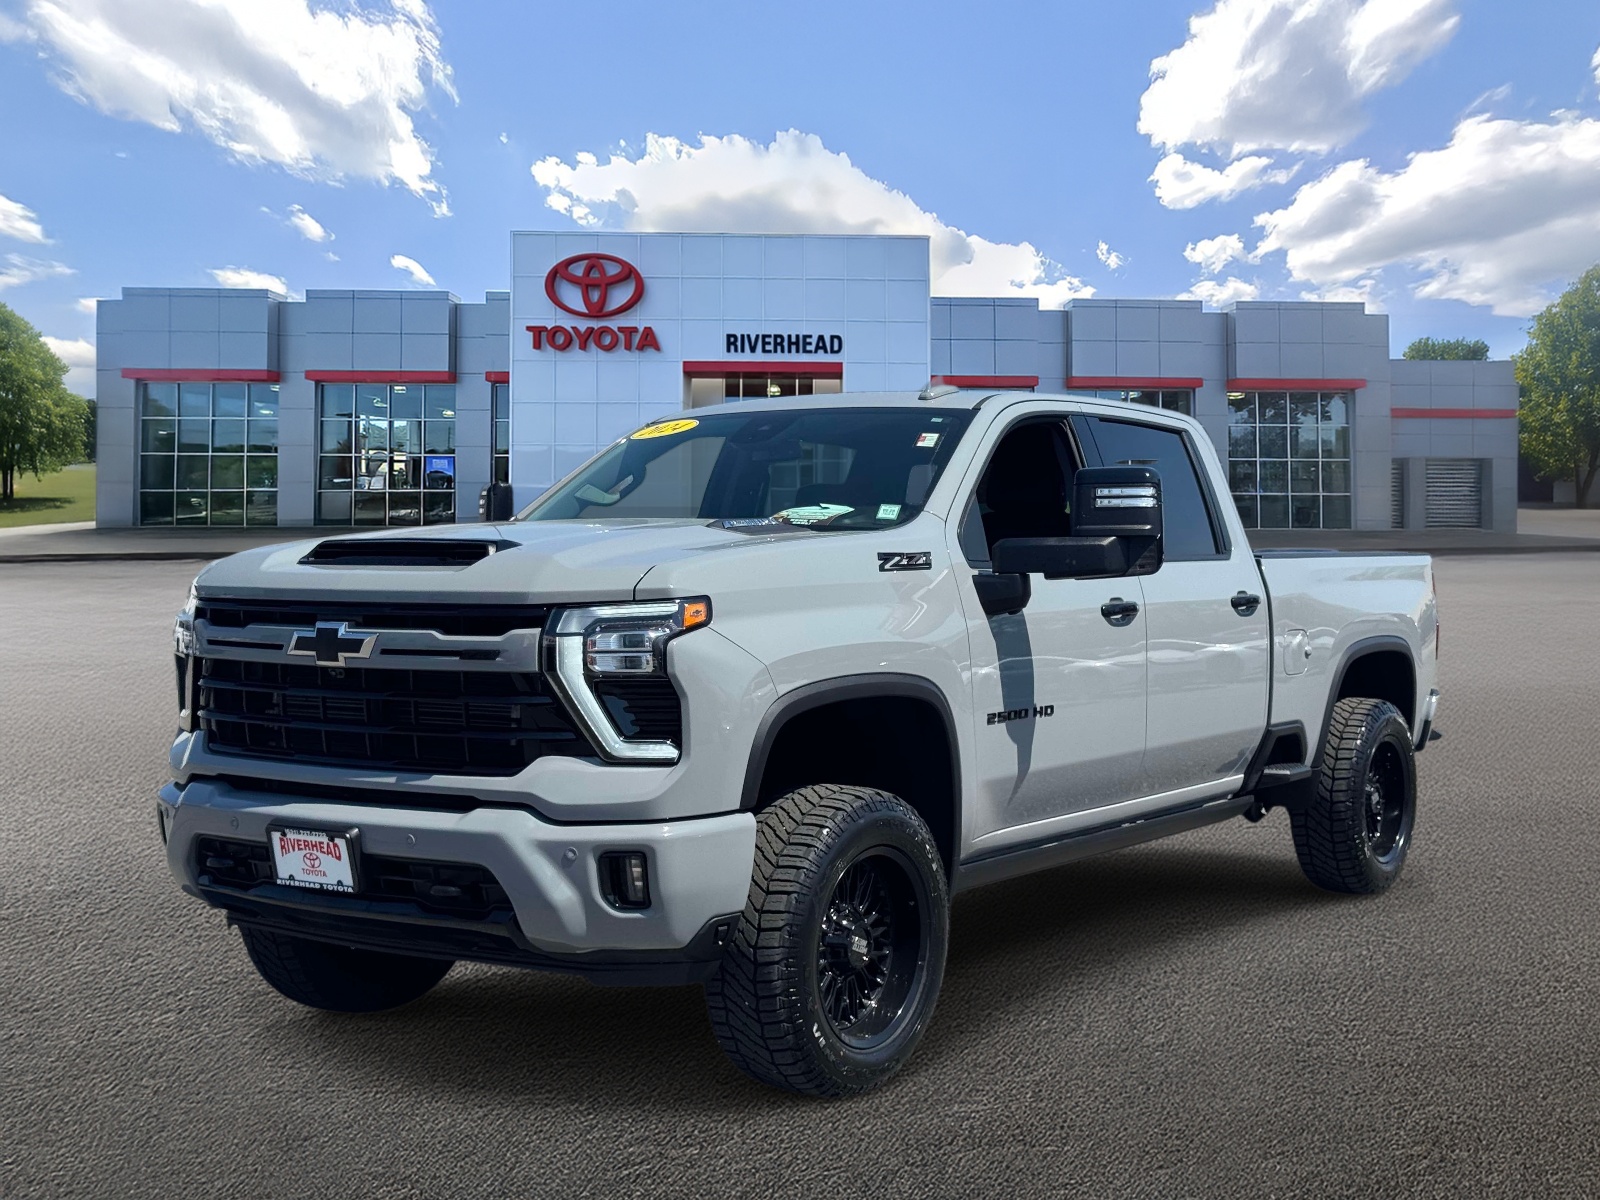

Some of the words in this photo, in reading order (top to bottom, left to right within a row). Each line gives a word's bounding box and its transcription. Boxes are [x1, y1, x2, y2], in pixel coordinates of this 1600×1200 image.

[526, 325, 661, 353] TOYOTA
[726, 333, 843, 355] RIVERHEAD
[877, 551, 932, 572] Z71
[987, 708, 1029, 726] 2500
[1032, 704, 1055, 718] HD
[279, 837, 341, 861] RIVERHEAD
[302, 868, 327, 877] TOYOTA
[277, 879, 320, 889] RIVERHEAD
[323, 884, 353, 892] TOYOTA
